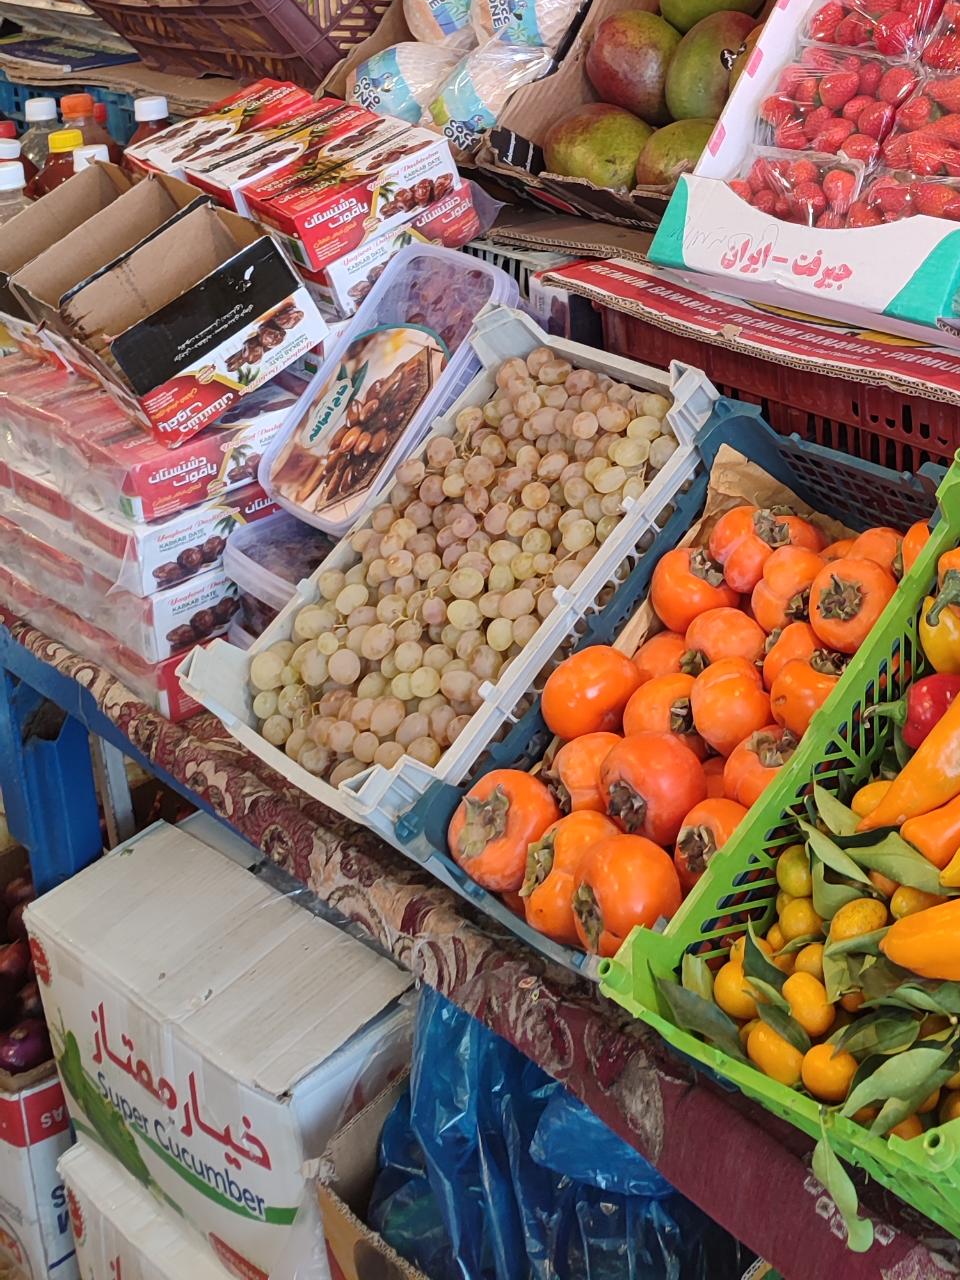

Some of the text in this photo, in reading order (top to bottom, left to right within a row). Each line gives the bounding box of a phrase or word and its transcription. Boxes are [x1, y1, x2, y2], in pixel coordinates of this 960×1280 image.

[352, 83, 377, 112] ONE
[359, 76, 382, 105] COCO
[304, 196, 358, 230] دشتستان
[328, 202, 369, 229] یاقوت
[415, 195, 461, 228] دشتستان
[441, 200, 474, 225] یاقوت
[347, 246, 386, 272] KABKAB DATE
[720, 238, 772, 274] ایران
[791, 248, 853, 291] جیرفت
[584, 264, 650, 290] PREMIUM
[650, 282, 721, 316] BANANAS
[726, 311, 803, 340] PREMIUM
[796, 330, 881, 356] BANANAS
[158, 401, 203, 434] یاقوت
[178, 392, 234, 433] دشتستان
[148, 455, 207, 485] دشتستان
[173, 461, 218, 488] یاقوت
[159, 528, 205, 549] KABKAB DATE
[172, 591, 218, 613] KABKAB DATE
[91, 1000, 272, 1172] خیار ممتاز
[97, 1070, 266, 1217] Super Cucumber
